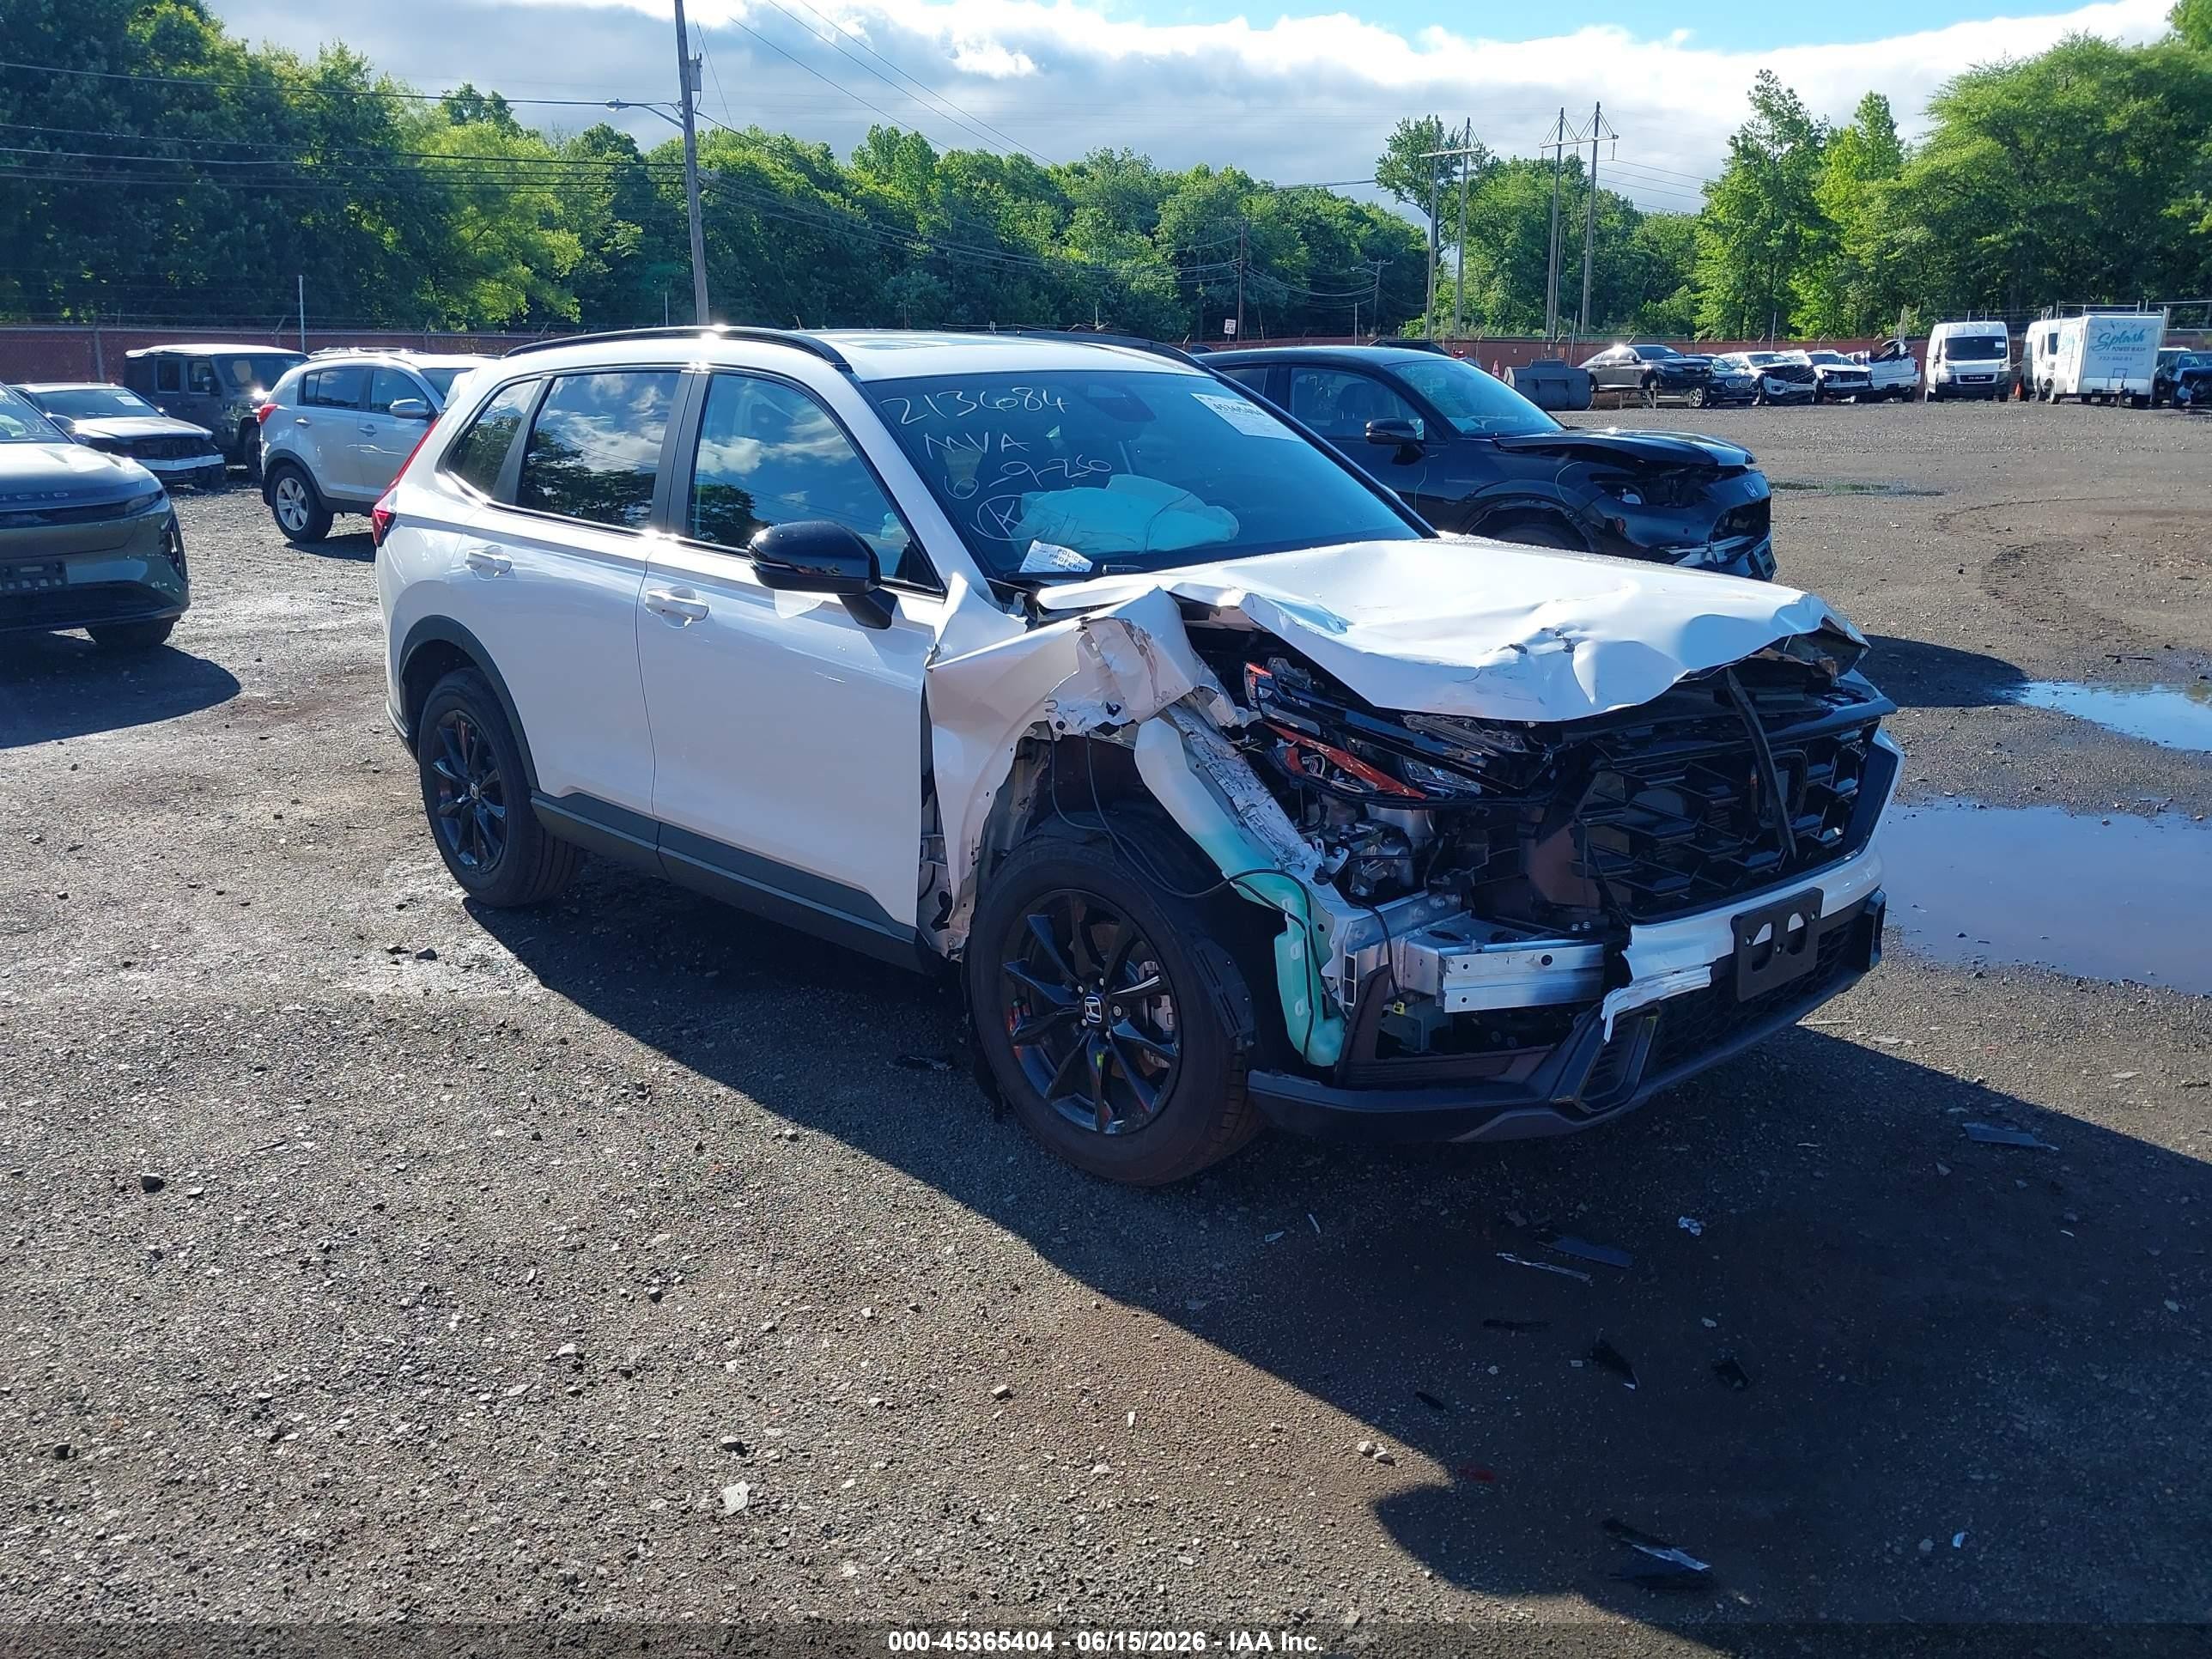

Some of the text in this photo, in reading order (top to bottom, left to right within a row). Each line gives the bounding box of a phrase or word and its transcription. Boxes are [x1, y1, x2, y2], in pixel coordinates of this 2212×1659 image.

[2092, 328, 2146, 351] Splash
[879, 386, 1070, 424] 213684
[1048, 553, 1086, 572] PROPERTY
[1056, 547, 1083, 565] POLICE
